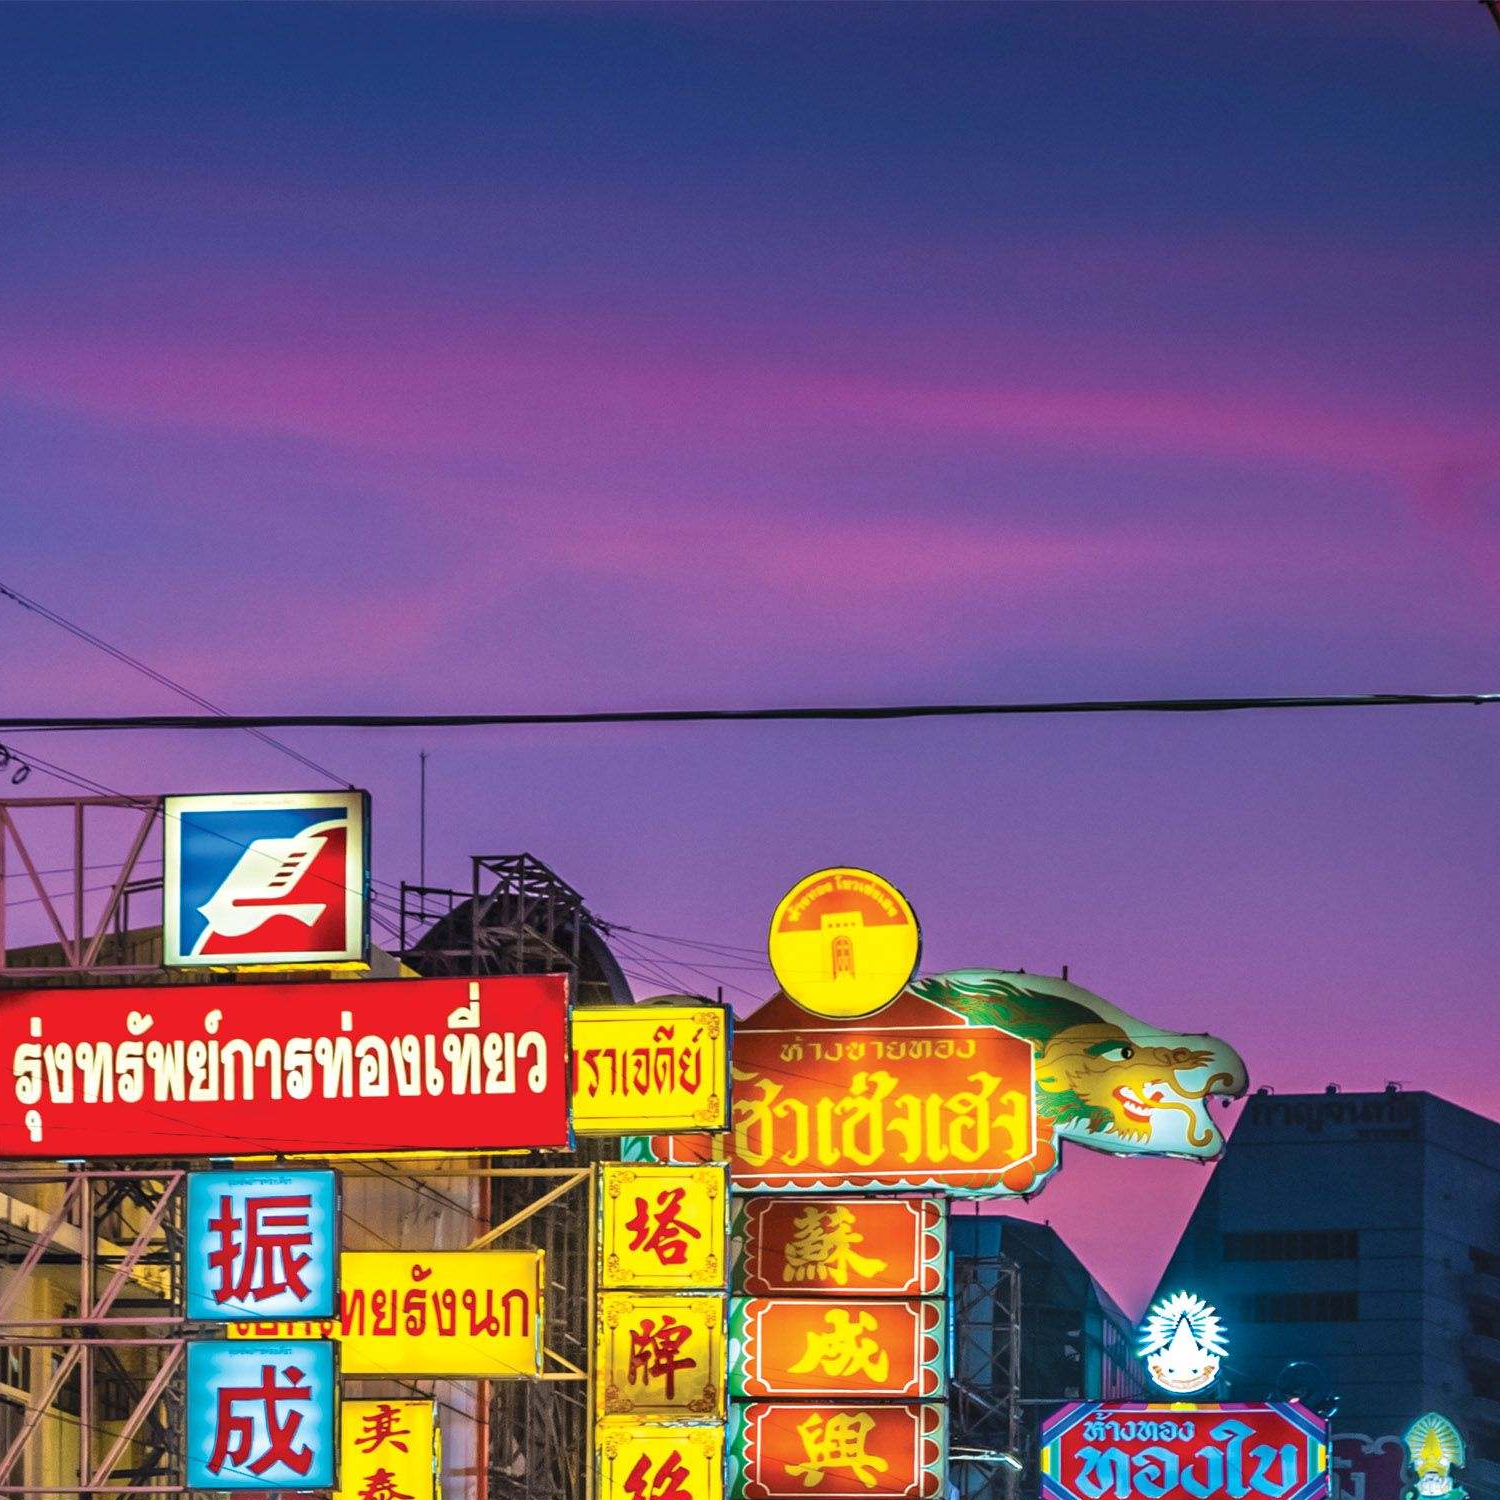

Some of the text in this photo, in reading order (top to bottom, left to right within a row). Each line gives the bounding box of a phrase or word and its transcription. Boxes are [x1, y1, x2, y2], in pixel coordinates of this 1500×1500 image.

[13, 982, 548, 1143] รุ่งทรัพย์การท่องเที่ยว
[1083, 1412, 1196, 1442] ห้างทอง
